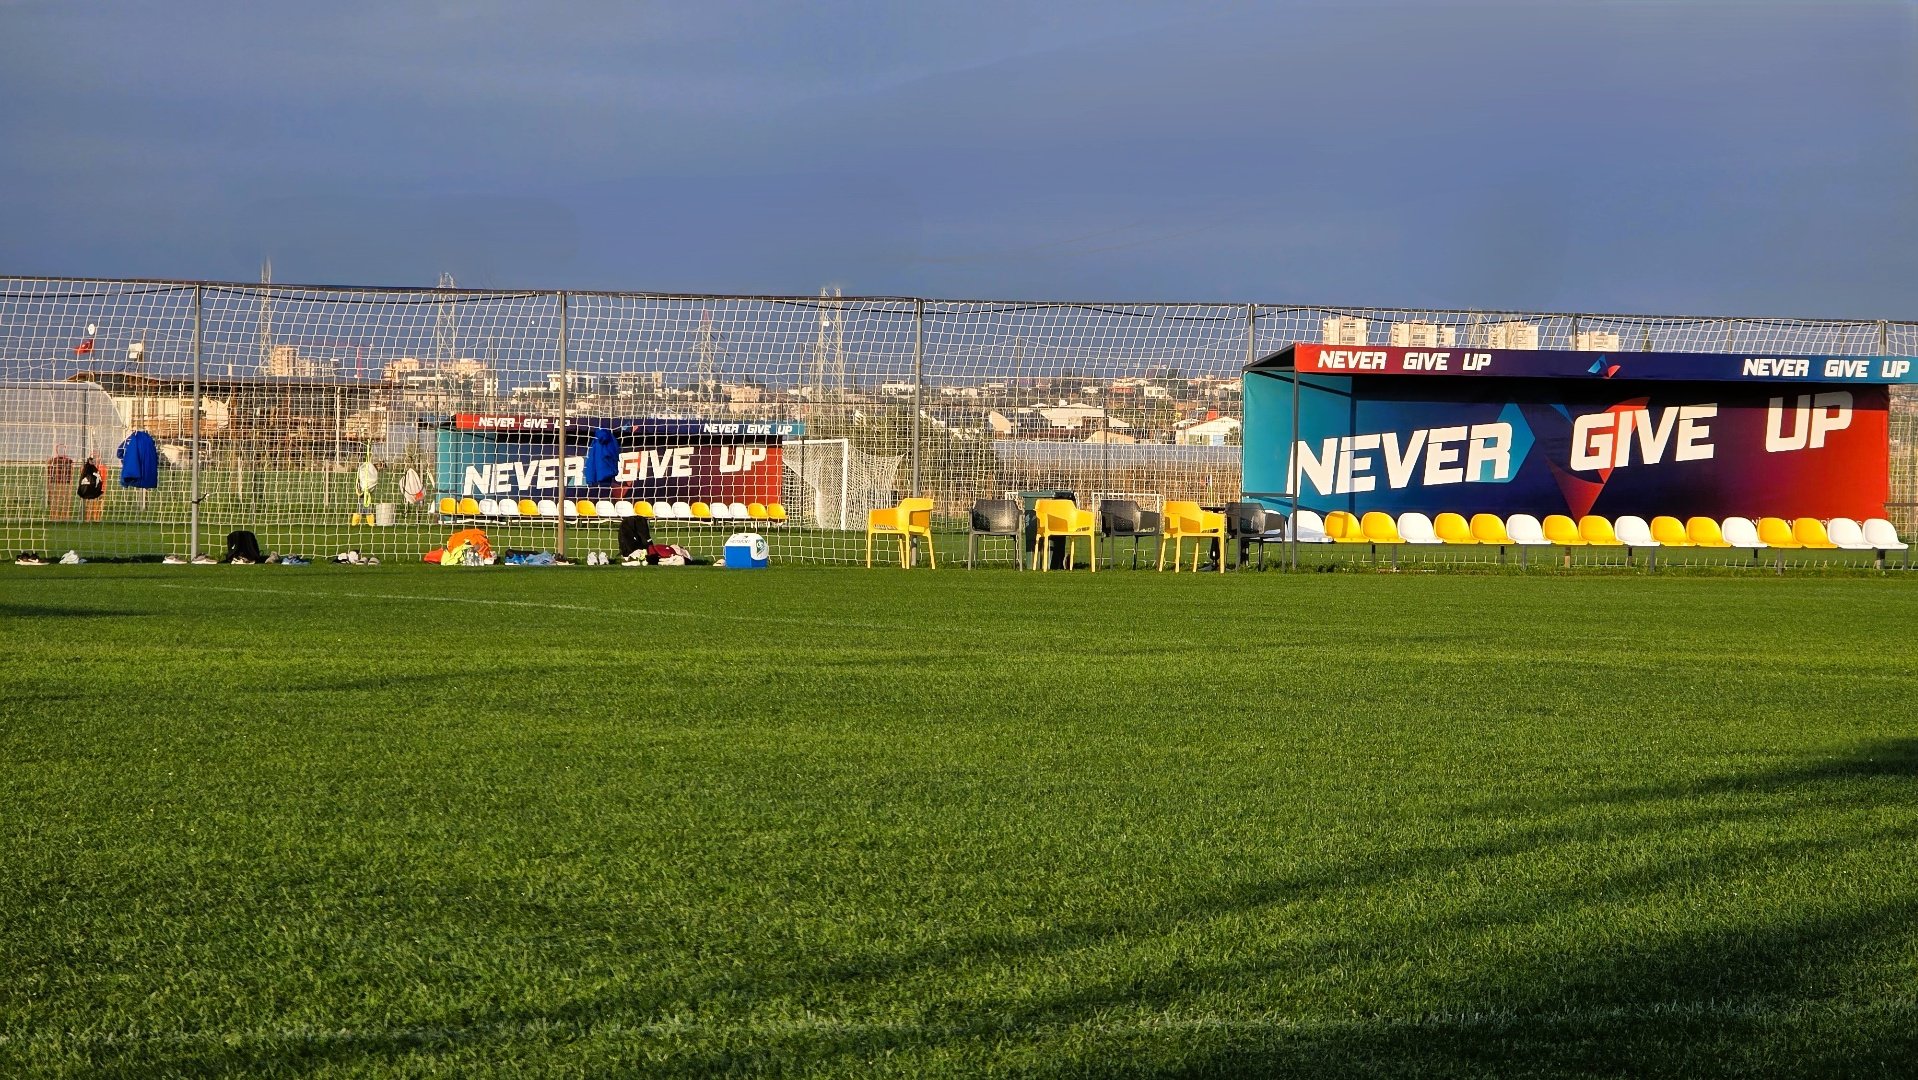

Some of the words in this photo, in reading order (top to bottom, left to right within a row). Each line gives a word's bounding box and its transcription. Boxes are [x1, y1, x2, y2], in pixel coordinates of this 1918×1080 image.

[1317, 350, 1387, 370] NEVER
[1402, 351, 1451, 371] GIVE
[1462, 352, 1492, 371] UP
[1742, 358, 1810, 377] NEVER
[1824, 359, 1870, 378] GIVE
[1881, 360, 1911, 378] UP
[478, 416, 516, 428] NEVER
[523, 418, 548, 429] GIVE
[703, 422, 740, 434] NEVER
[746, 424, 772, 435] GIVE
[777, 425, 793, 435] UP
[1286, 421, 1513, 499] NEVER
[1570, 402, 1718, 472] GIVE
[1765, 390, 1853, 453] UP
[464, 456, 585, 496] NEVER
[615, 446, 695, 483] GIVE
[719, 440, 767, 473] UP
